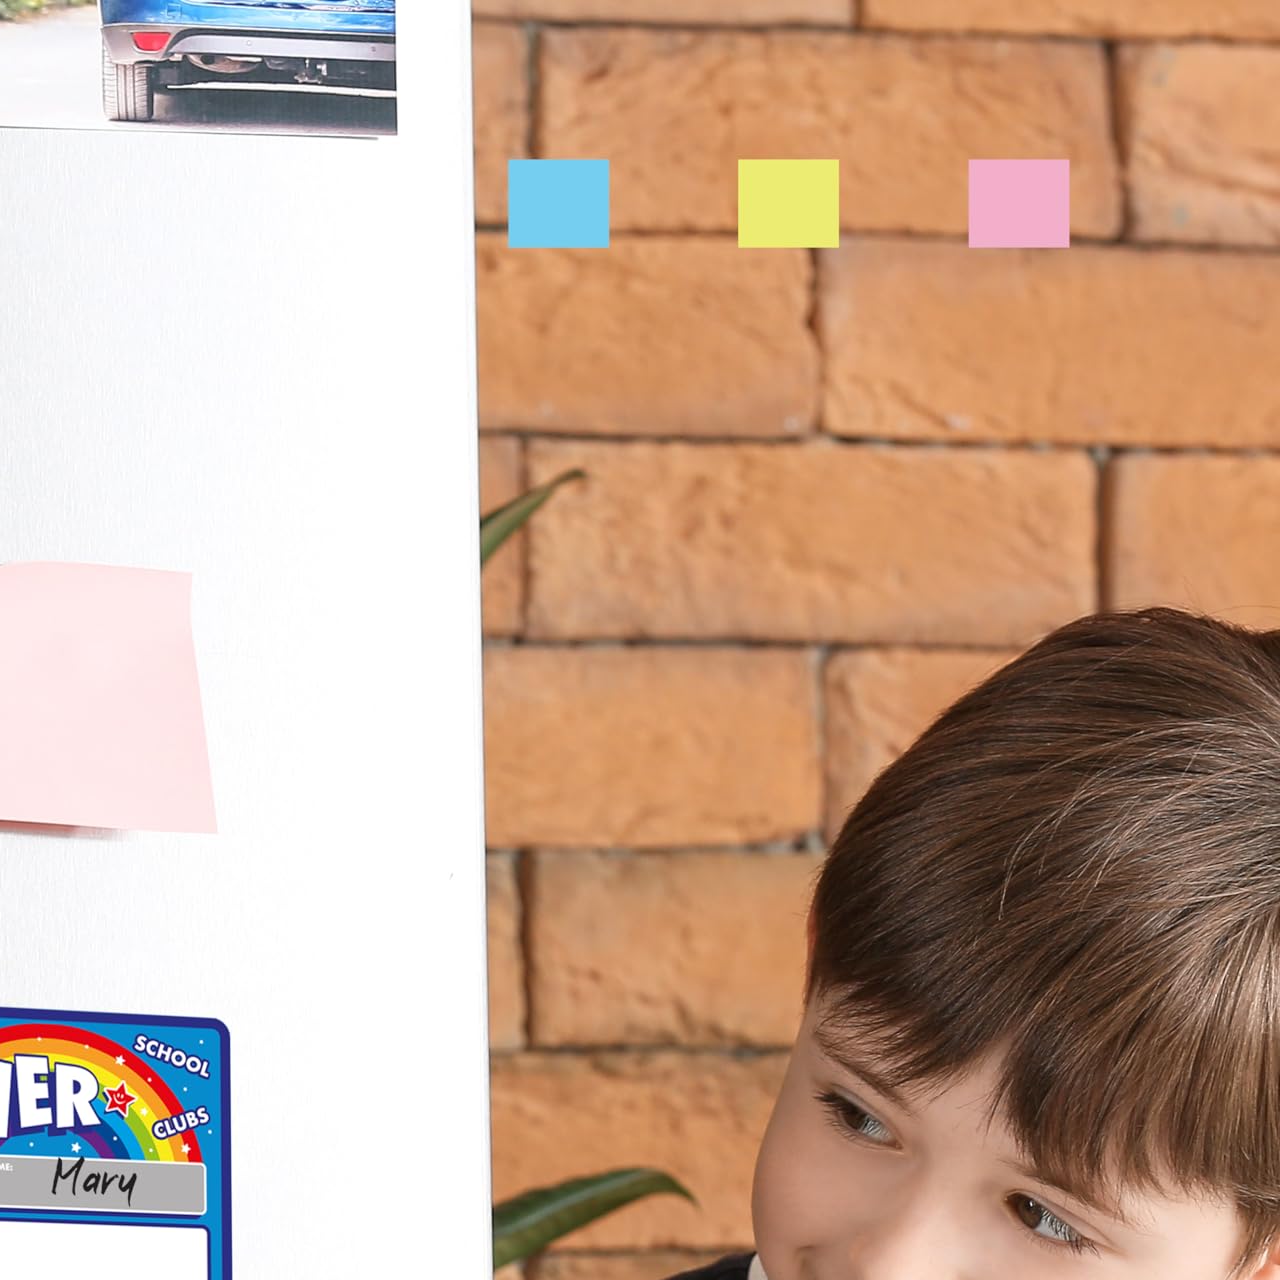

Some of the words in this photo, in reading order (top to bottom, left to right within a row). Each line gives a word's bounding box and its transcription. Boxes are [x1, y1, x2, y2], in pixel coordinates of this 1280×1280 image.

[134, 1035, 210, 1077] SCHOOL
[152, 1106, 210, 1140] CLUBS
[51, 1157, 138, 1206] Mary
